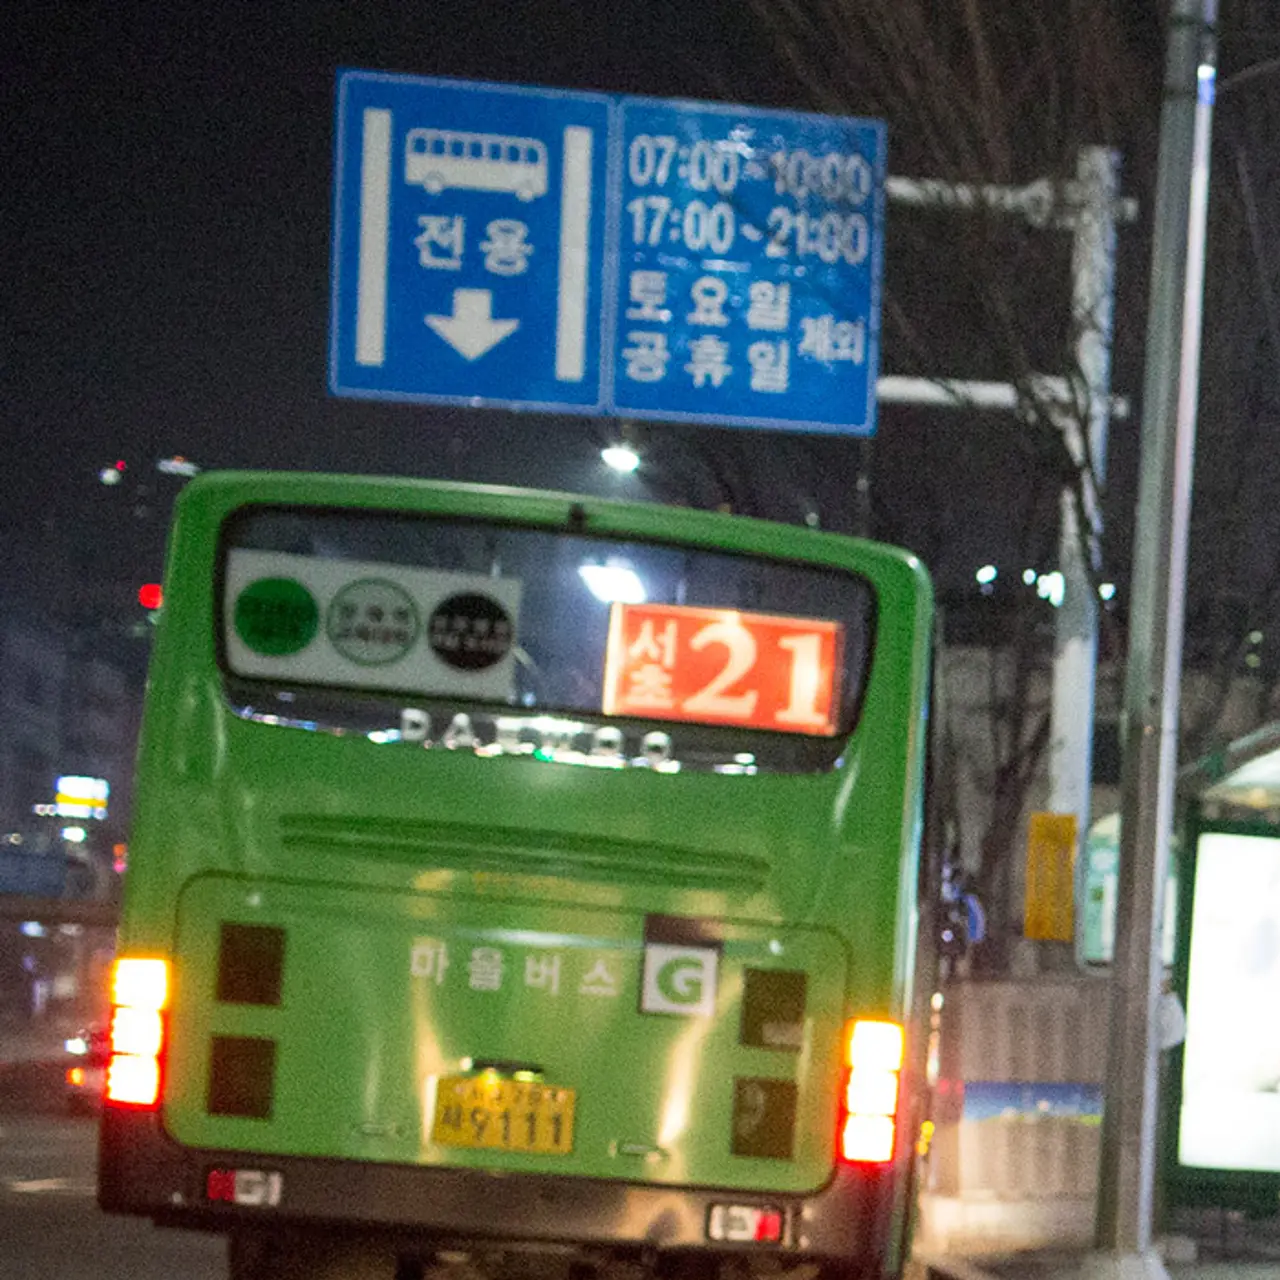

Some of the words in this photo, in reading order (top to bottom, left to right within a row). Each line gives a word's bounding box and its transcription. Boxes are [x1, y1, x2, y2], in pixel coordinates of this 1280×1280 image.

[413, 214, 535, 276] 전용
[624, 269, 792, 333] 토요일
[621, 331, 792, 393] 공휴일
[627, 618, 679, 709] 서초
[681, 618, 831, 726] 21
[409, 942, 622, 996] 마을버스
